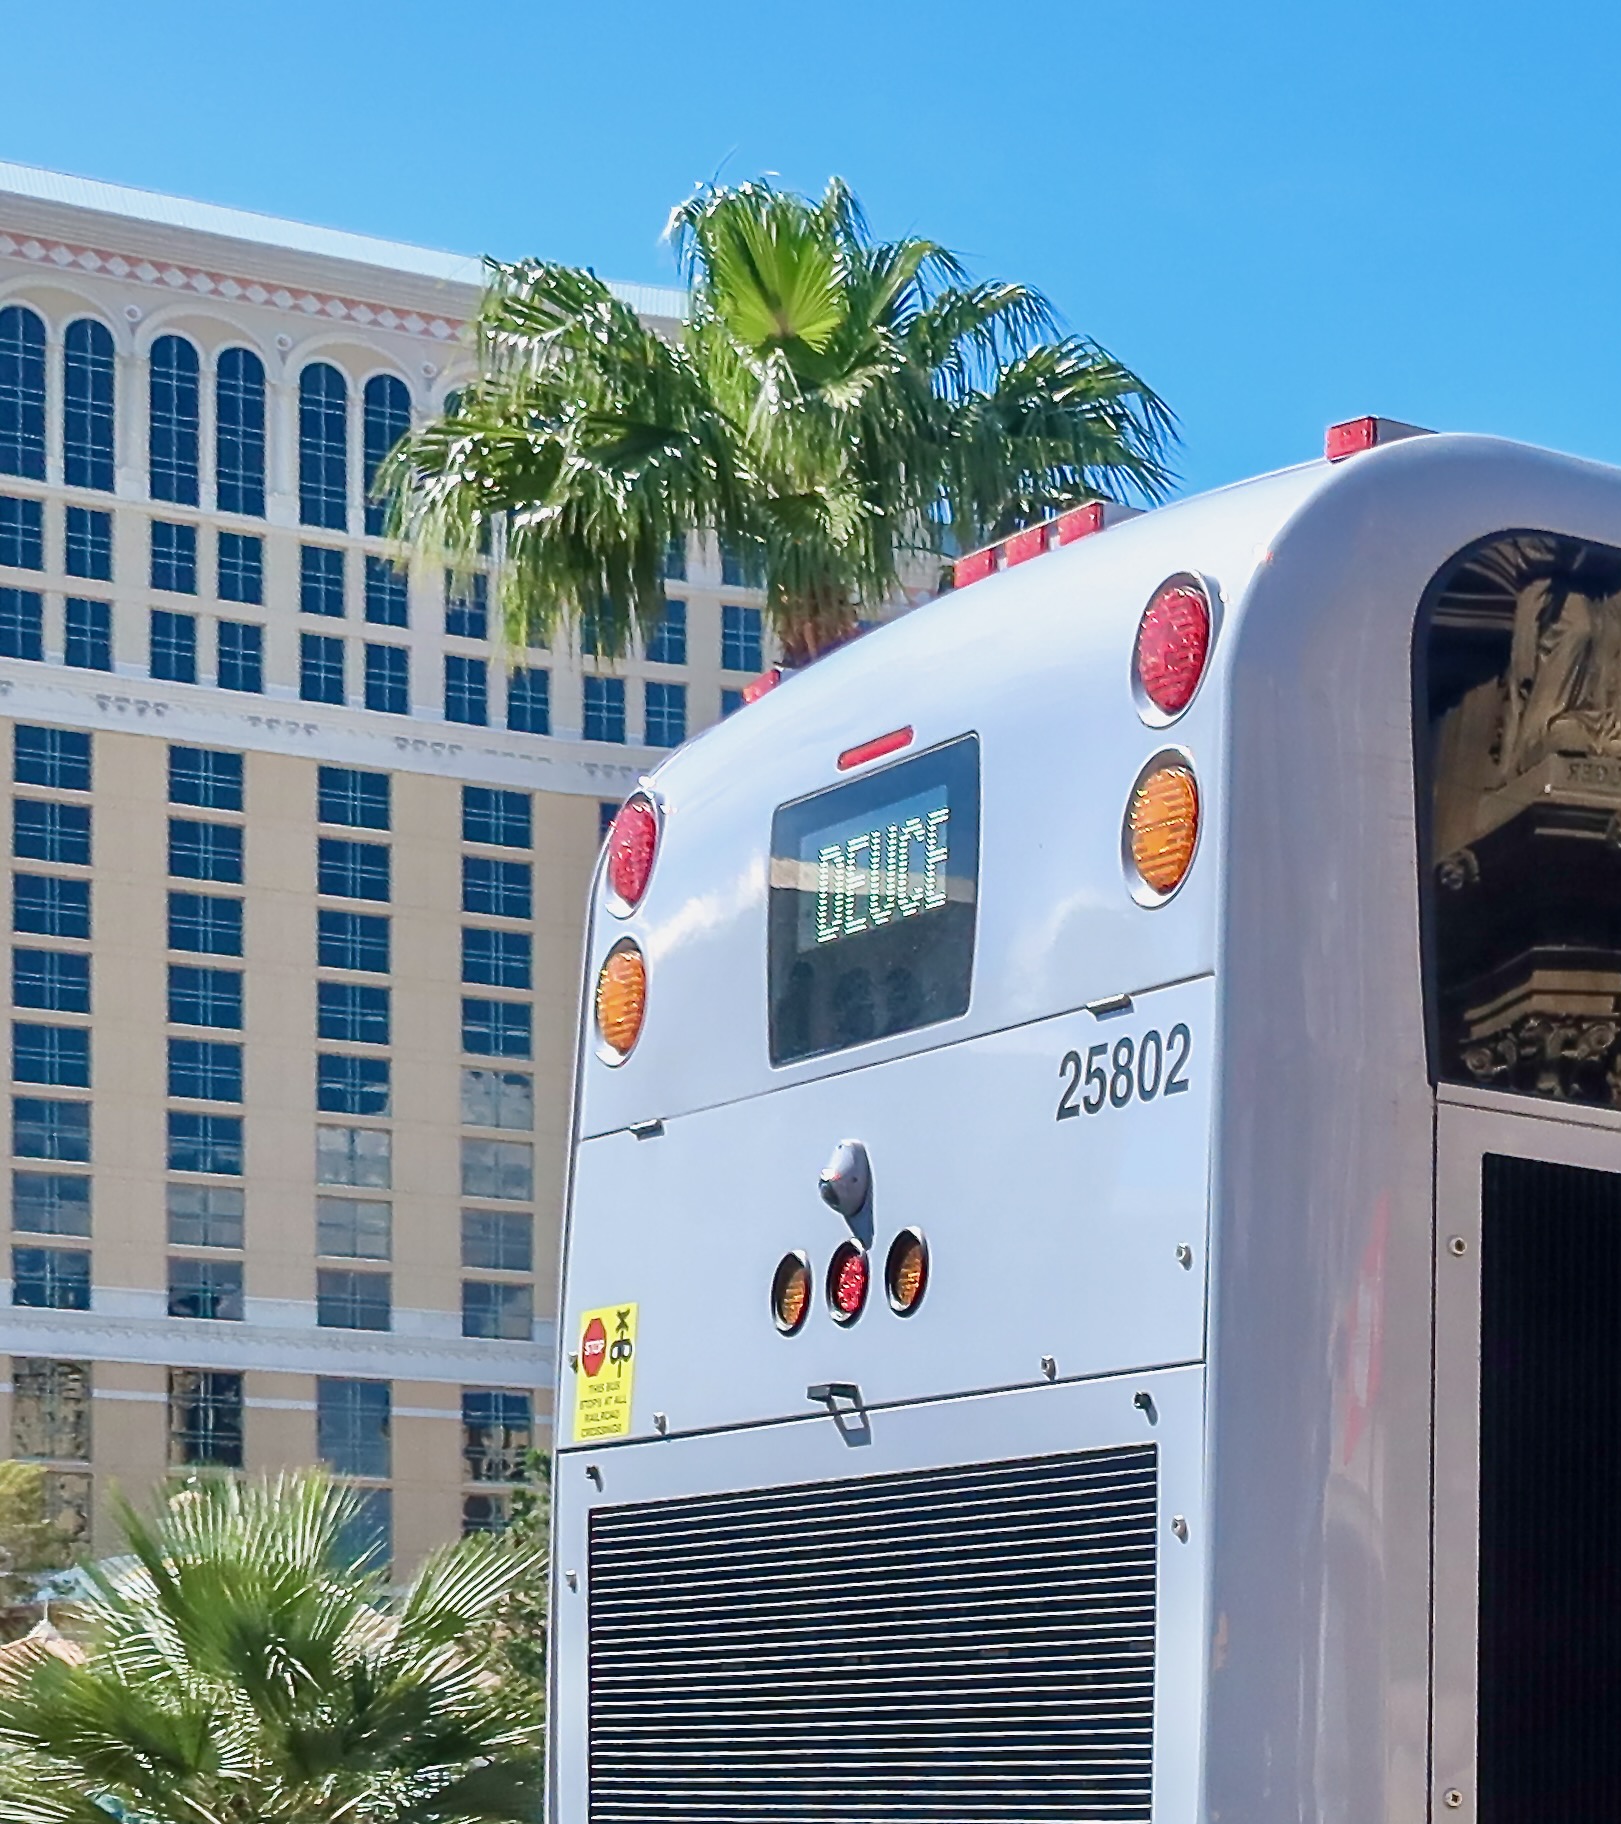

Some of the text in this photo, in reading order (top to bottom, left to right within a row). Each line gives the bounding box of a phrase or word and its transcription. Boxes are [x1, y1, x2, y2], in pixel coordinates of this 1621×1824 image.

[816, 806, 949, 943] DEUCE
[1055, 1022, 1192, 1122] 25802
[584, 1340, 604, 1356] STOP
